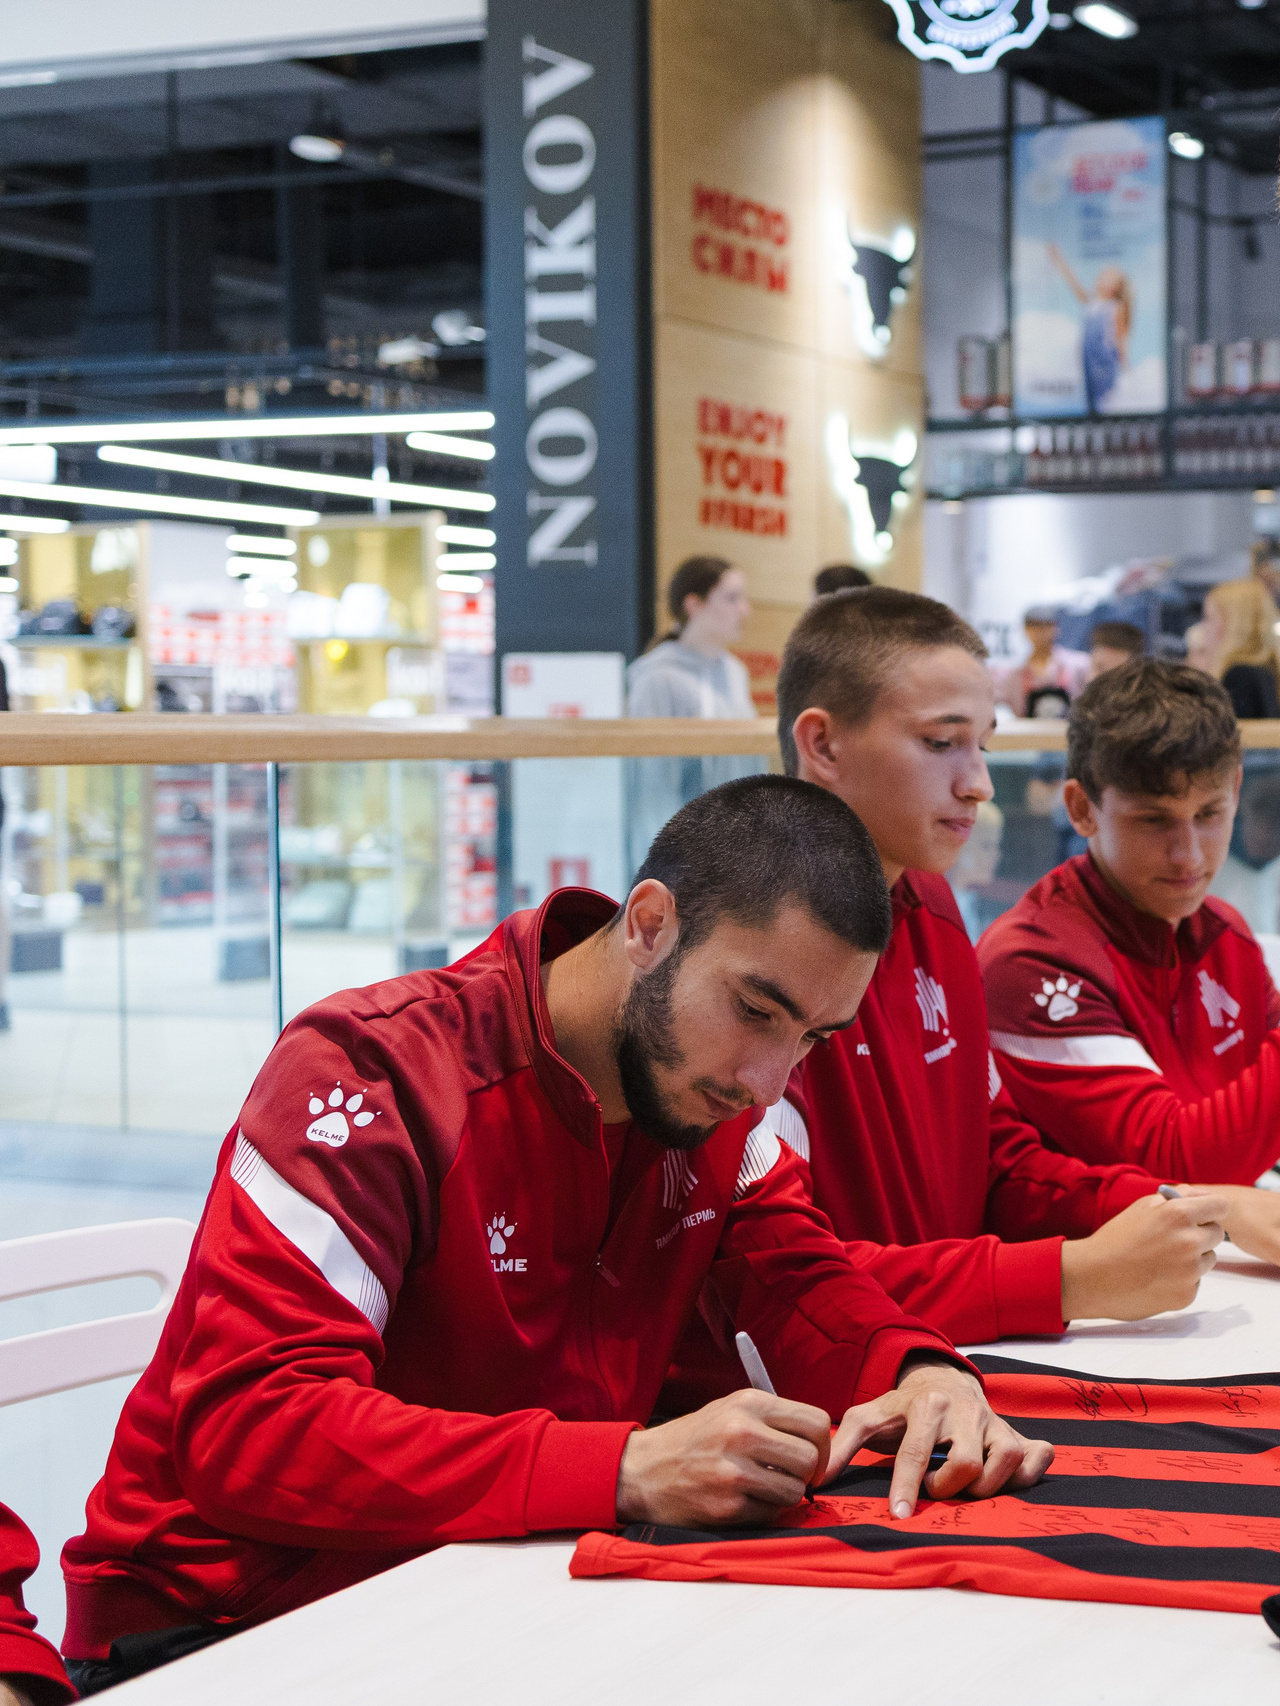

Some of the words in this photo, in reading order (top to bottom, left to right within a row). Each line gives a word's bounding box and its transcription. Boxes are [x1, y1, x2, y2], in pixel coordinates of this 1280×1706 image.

[521, 34, 598, 569] NOVIKOV
[698, 398, 788, 446] ENJOY
[698, 442, 788, 497] YOUR
[310, 1127, 345, 1142] KELME
[681, 1207, 716, 1229] ПЕРМЬ
[491, 1259, 528, 1272] LME
